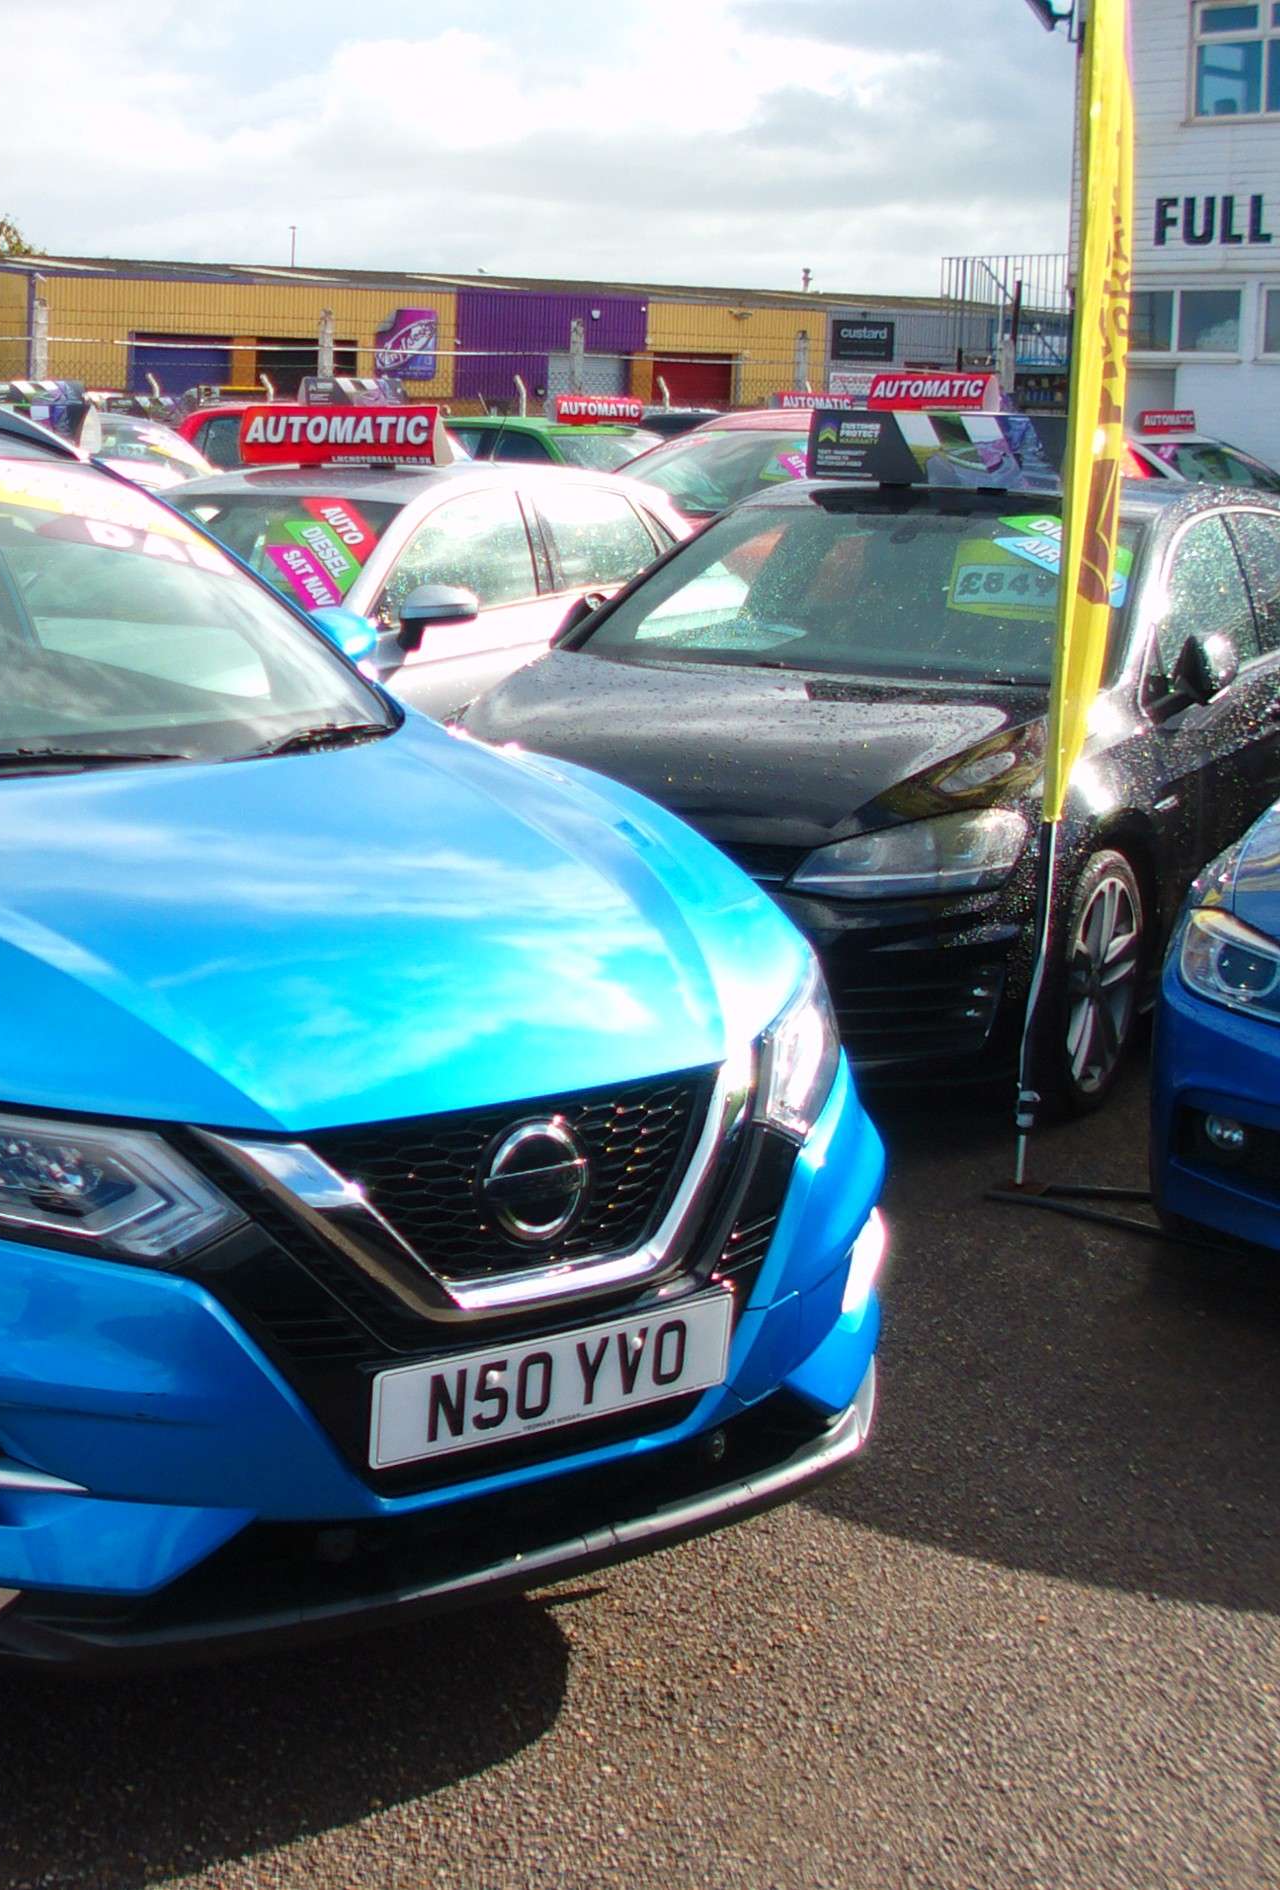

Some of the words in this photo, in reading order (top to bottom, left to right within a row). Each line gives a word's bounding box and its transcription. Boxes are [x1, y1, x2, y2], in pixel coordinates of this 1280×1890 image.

[1153, 194, 1273, 246] FULL
[840, 326, 888, 340] custard
[873, 379, 984, 398] AUTOMATIC
[559, 401, 640, 417] AUTOMATIC
[782, 395, 852, 410] AUTOMATIC
[245, 416, 430, 445] AUTOMATIC
[1144, 414, 1195, 426] AUTOMATIC
[320, 506, 365, 545] AUTO
[300, 526, 352, 579] DIESEL
[1014, 539, 1062, 564] AIR
[282, 549, 315, 576] SAT
[301, 575, 337, 607] NAV
[427, 1351, 553, 1443] N50
